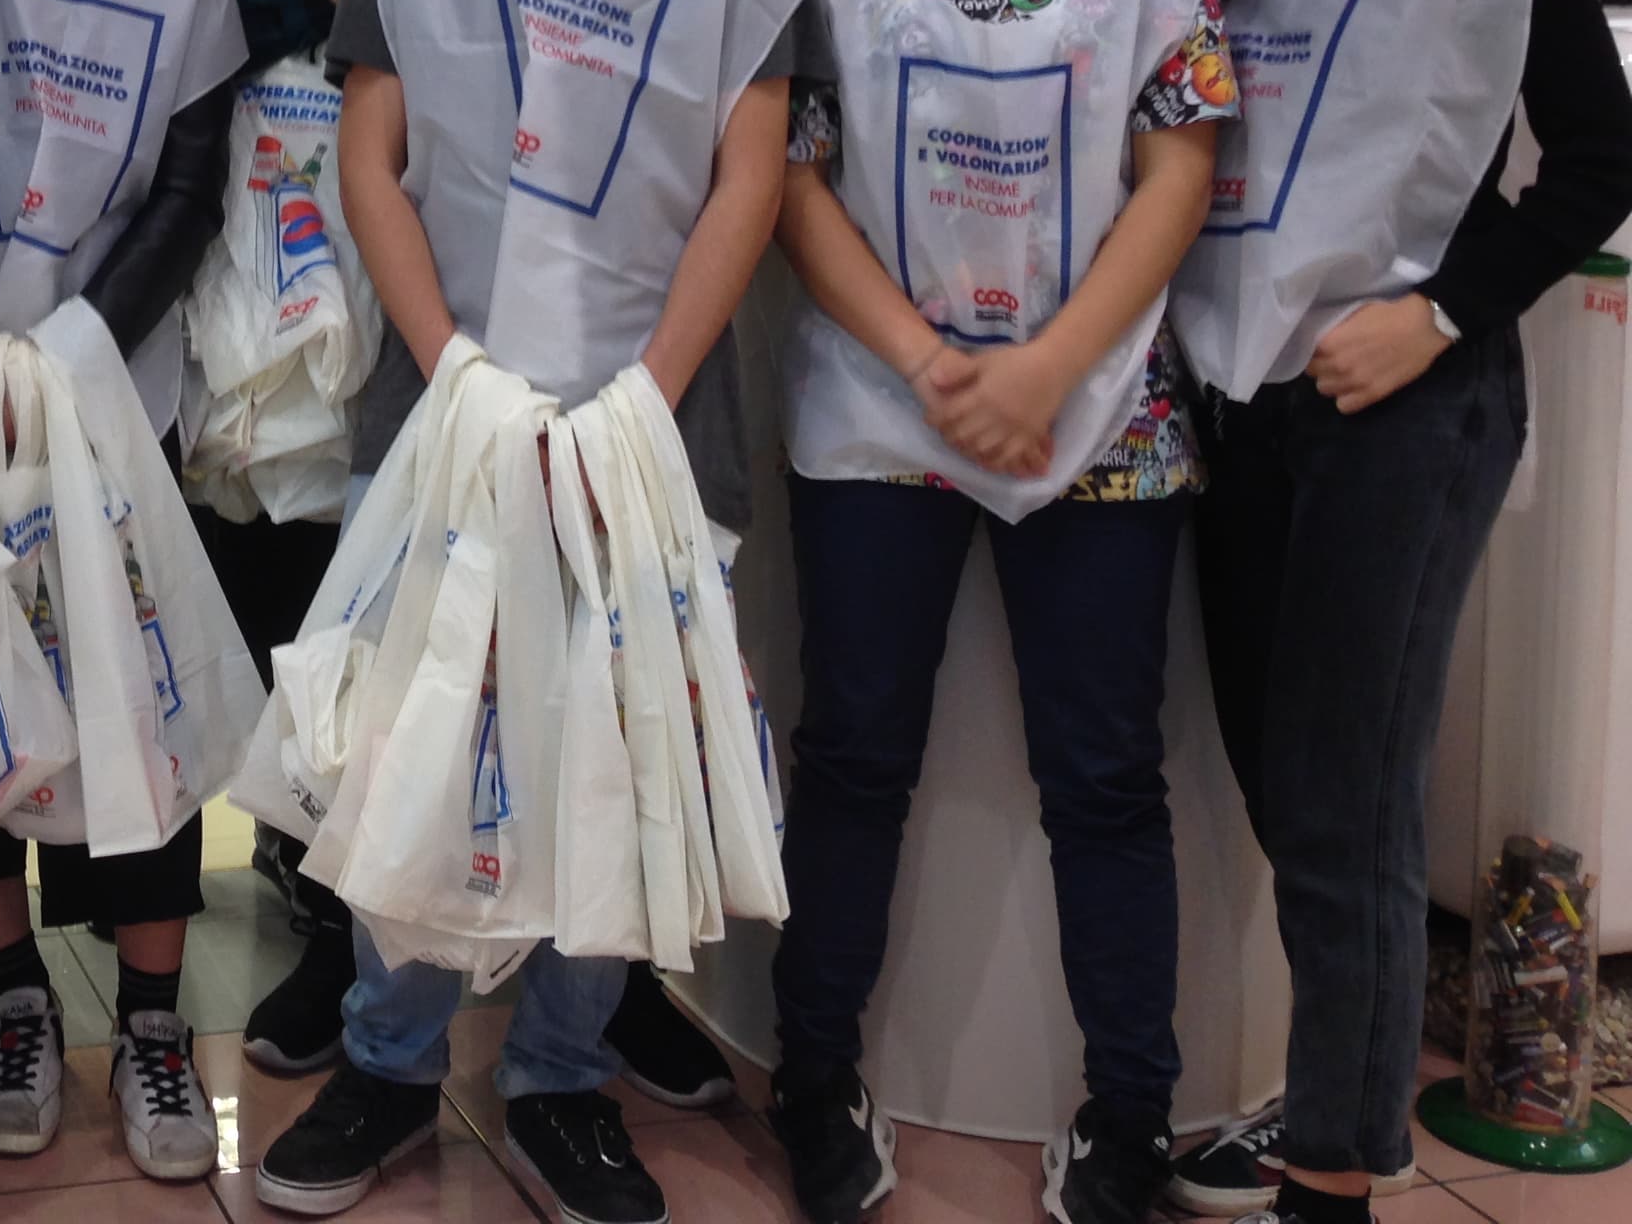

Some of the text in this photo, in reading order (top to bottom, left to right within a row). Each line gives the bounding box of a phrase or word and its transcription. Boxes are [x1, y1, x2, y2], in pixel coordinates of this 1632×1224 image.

[918, 148, 928, 162] E
[964, 174, 1021, 196] INSIEME
[929, 190, 956, 207] PER
[960, 193, 976, 209] LA
